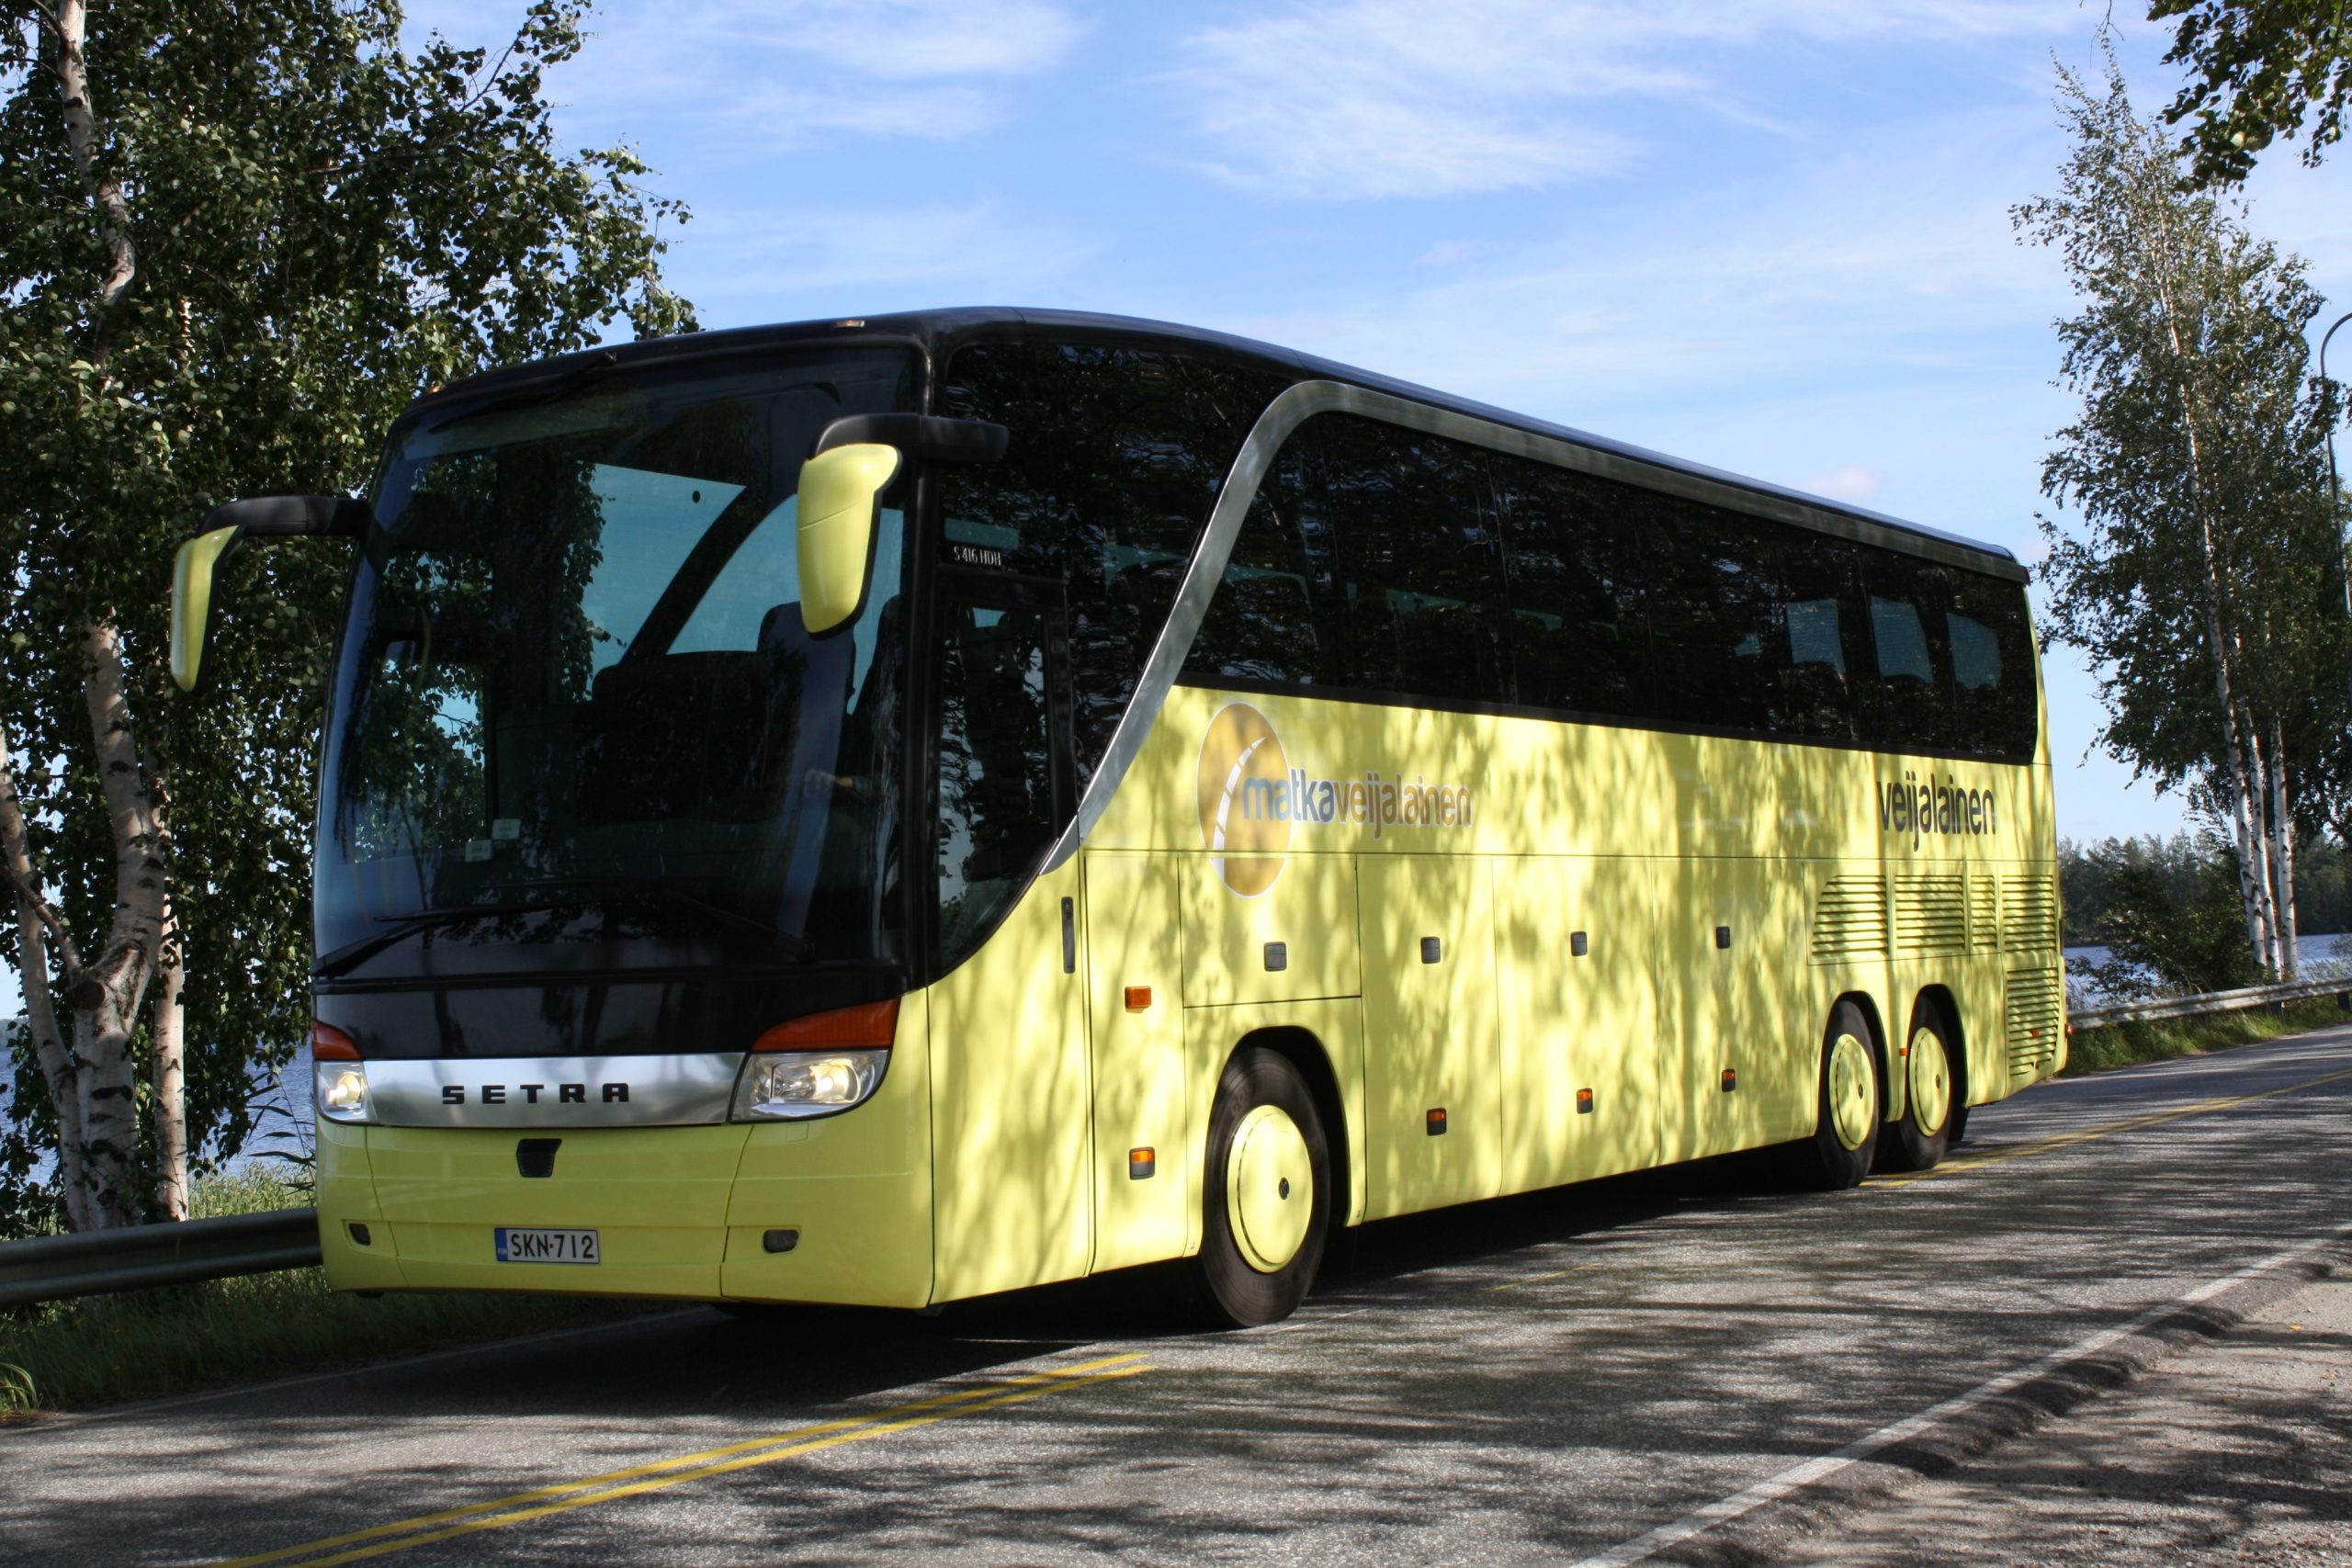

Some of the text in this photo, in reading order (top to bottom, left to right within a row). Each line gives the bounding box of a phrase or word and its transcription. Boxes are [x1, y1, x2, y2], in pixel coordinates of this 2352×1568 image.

[979, 549, 1001, 566] HDH
[1243, 767, 1471, 840] matkaveijalainen
[1877, 771, 1996, 852] veijalainen
[442, 1083, 629, 1105] SETRA
[511, 1234, 594, 1258] SKN-712
